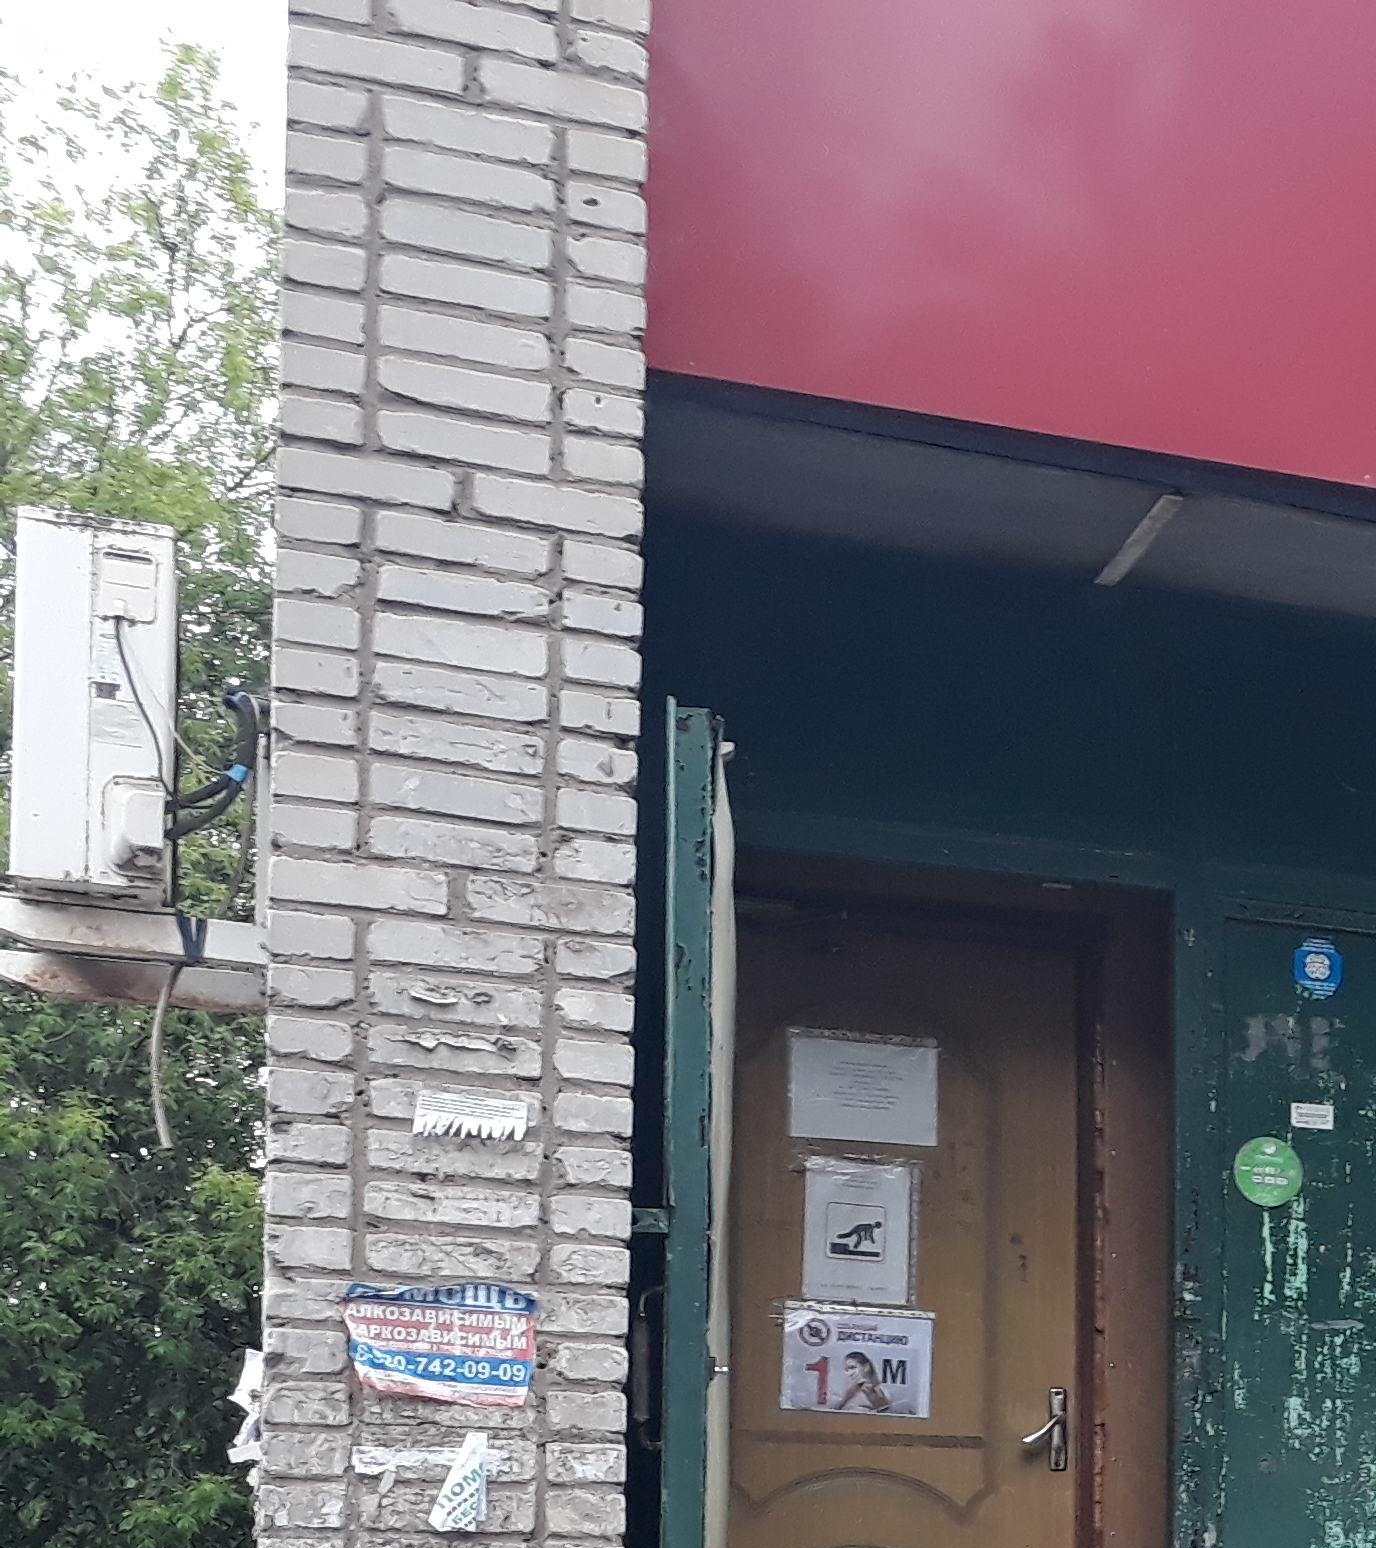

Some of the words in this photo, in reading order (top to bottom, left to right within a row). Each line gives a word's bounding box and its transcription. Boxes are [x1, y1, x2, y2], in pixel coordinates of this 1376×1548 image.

[350, 1284, 529, 1309] МОЩЬ
[345, 1303, 528, 1334] АЛКОЗАВИСИМЫМ
[837, 1331, 909, 1345] ДИСТАНЦИЮ
[805, 1355, 829, 1404] 1
